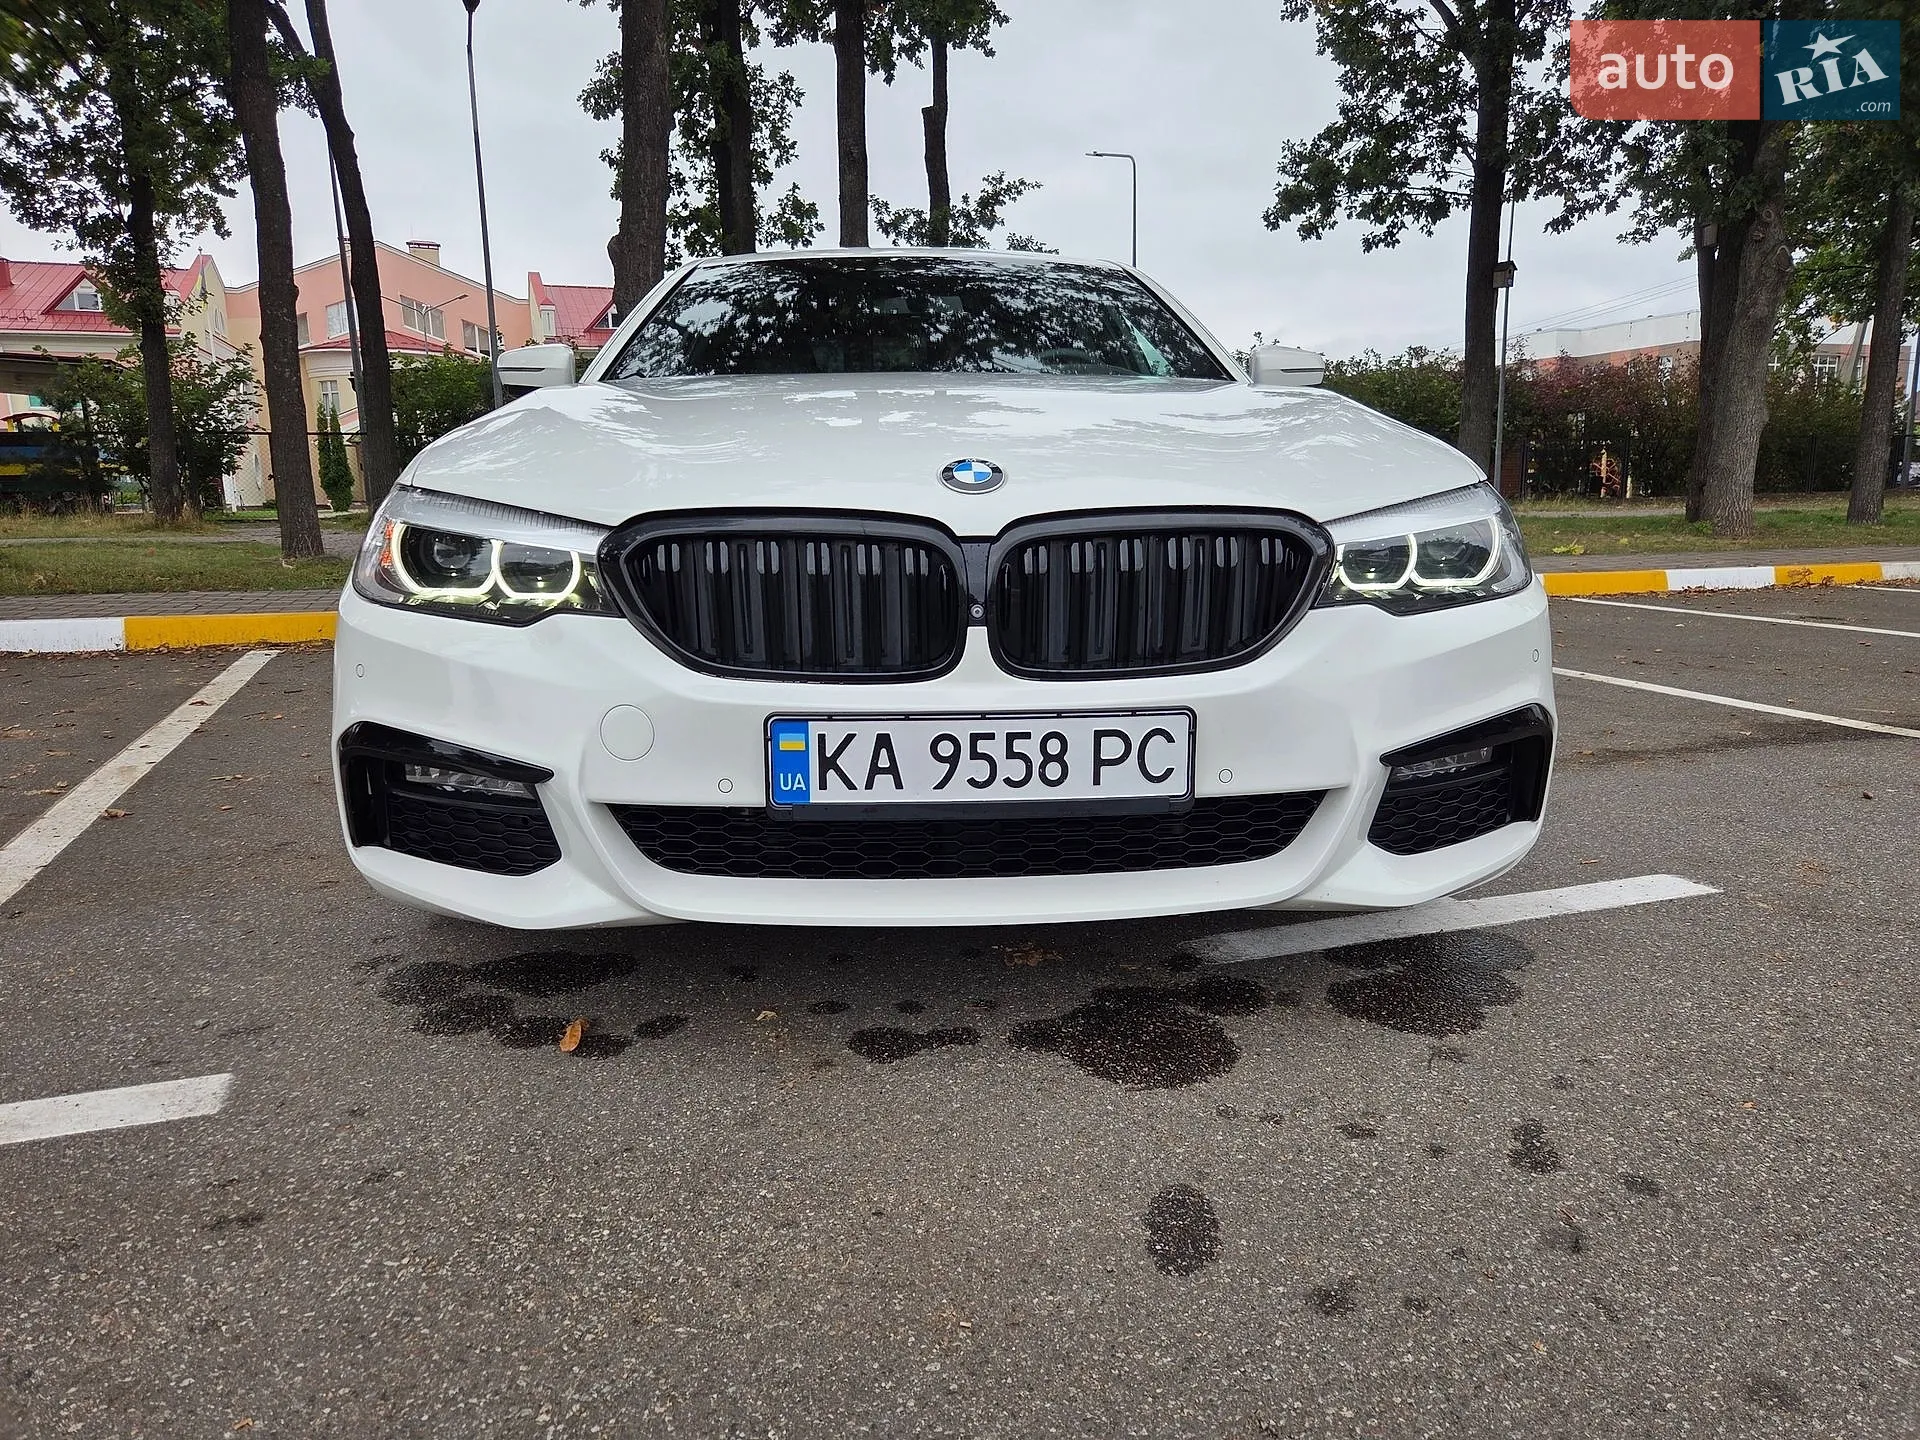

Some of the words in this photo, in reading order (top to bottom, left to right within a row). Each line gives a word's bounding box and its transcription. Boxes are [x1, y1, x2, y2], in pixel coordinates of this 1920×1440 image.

[817, 732, 904, 791] KA
[929, 731, 1069, 790] 9558
[1093, 727, 1176, 786] PC
[780, 773, 806, 791] UA
